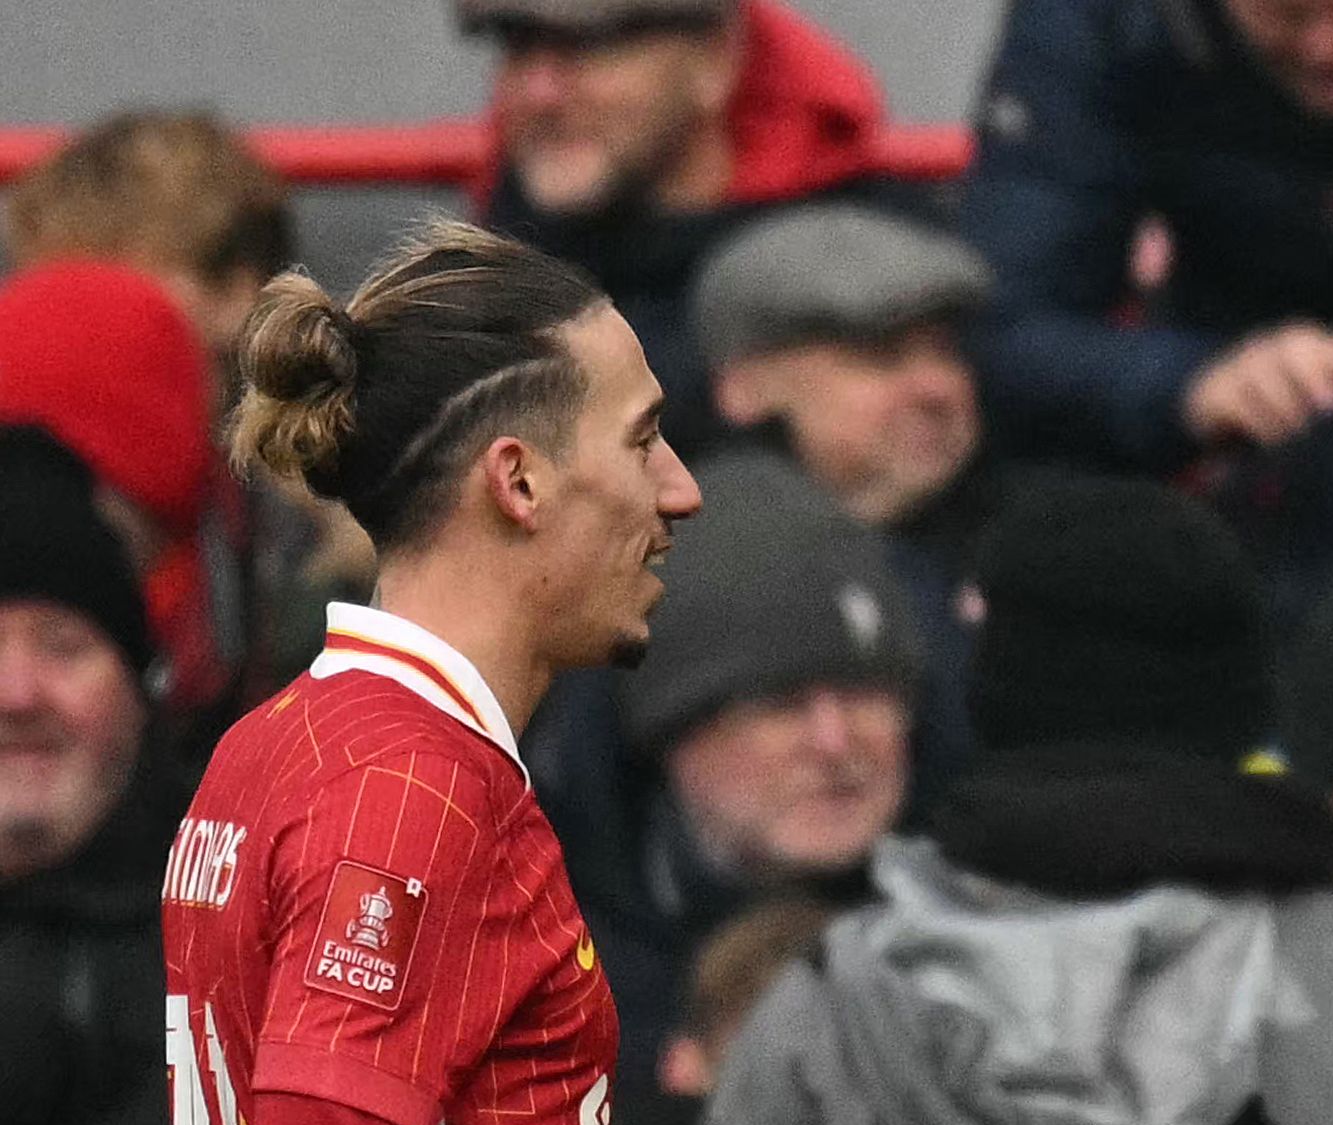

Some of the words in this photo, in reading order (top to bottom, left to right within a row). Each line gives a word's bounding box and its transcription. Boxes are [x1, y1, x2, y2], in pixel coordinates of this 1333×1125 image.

[316, 958, 343, 982] FA
[347, 968, 394, 994] CUP
[322, 940, 397, 977] Emirates
